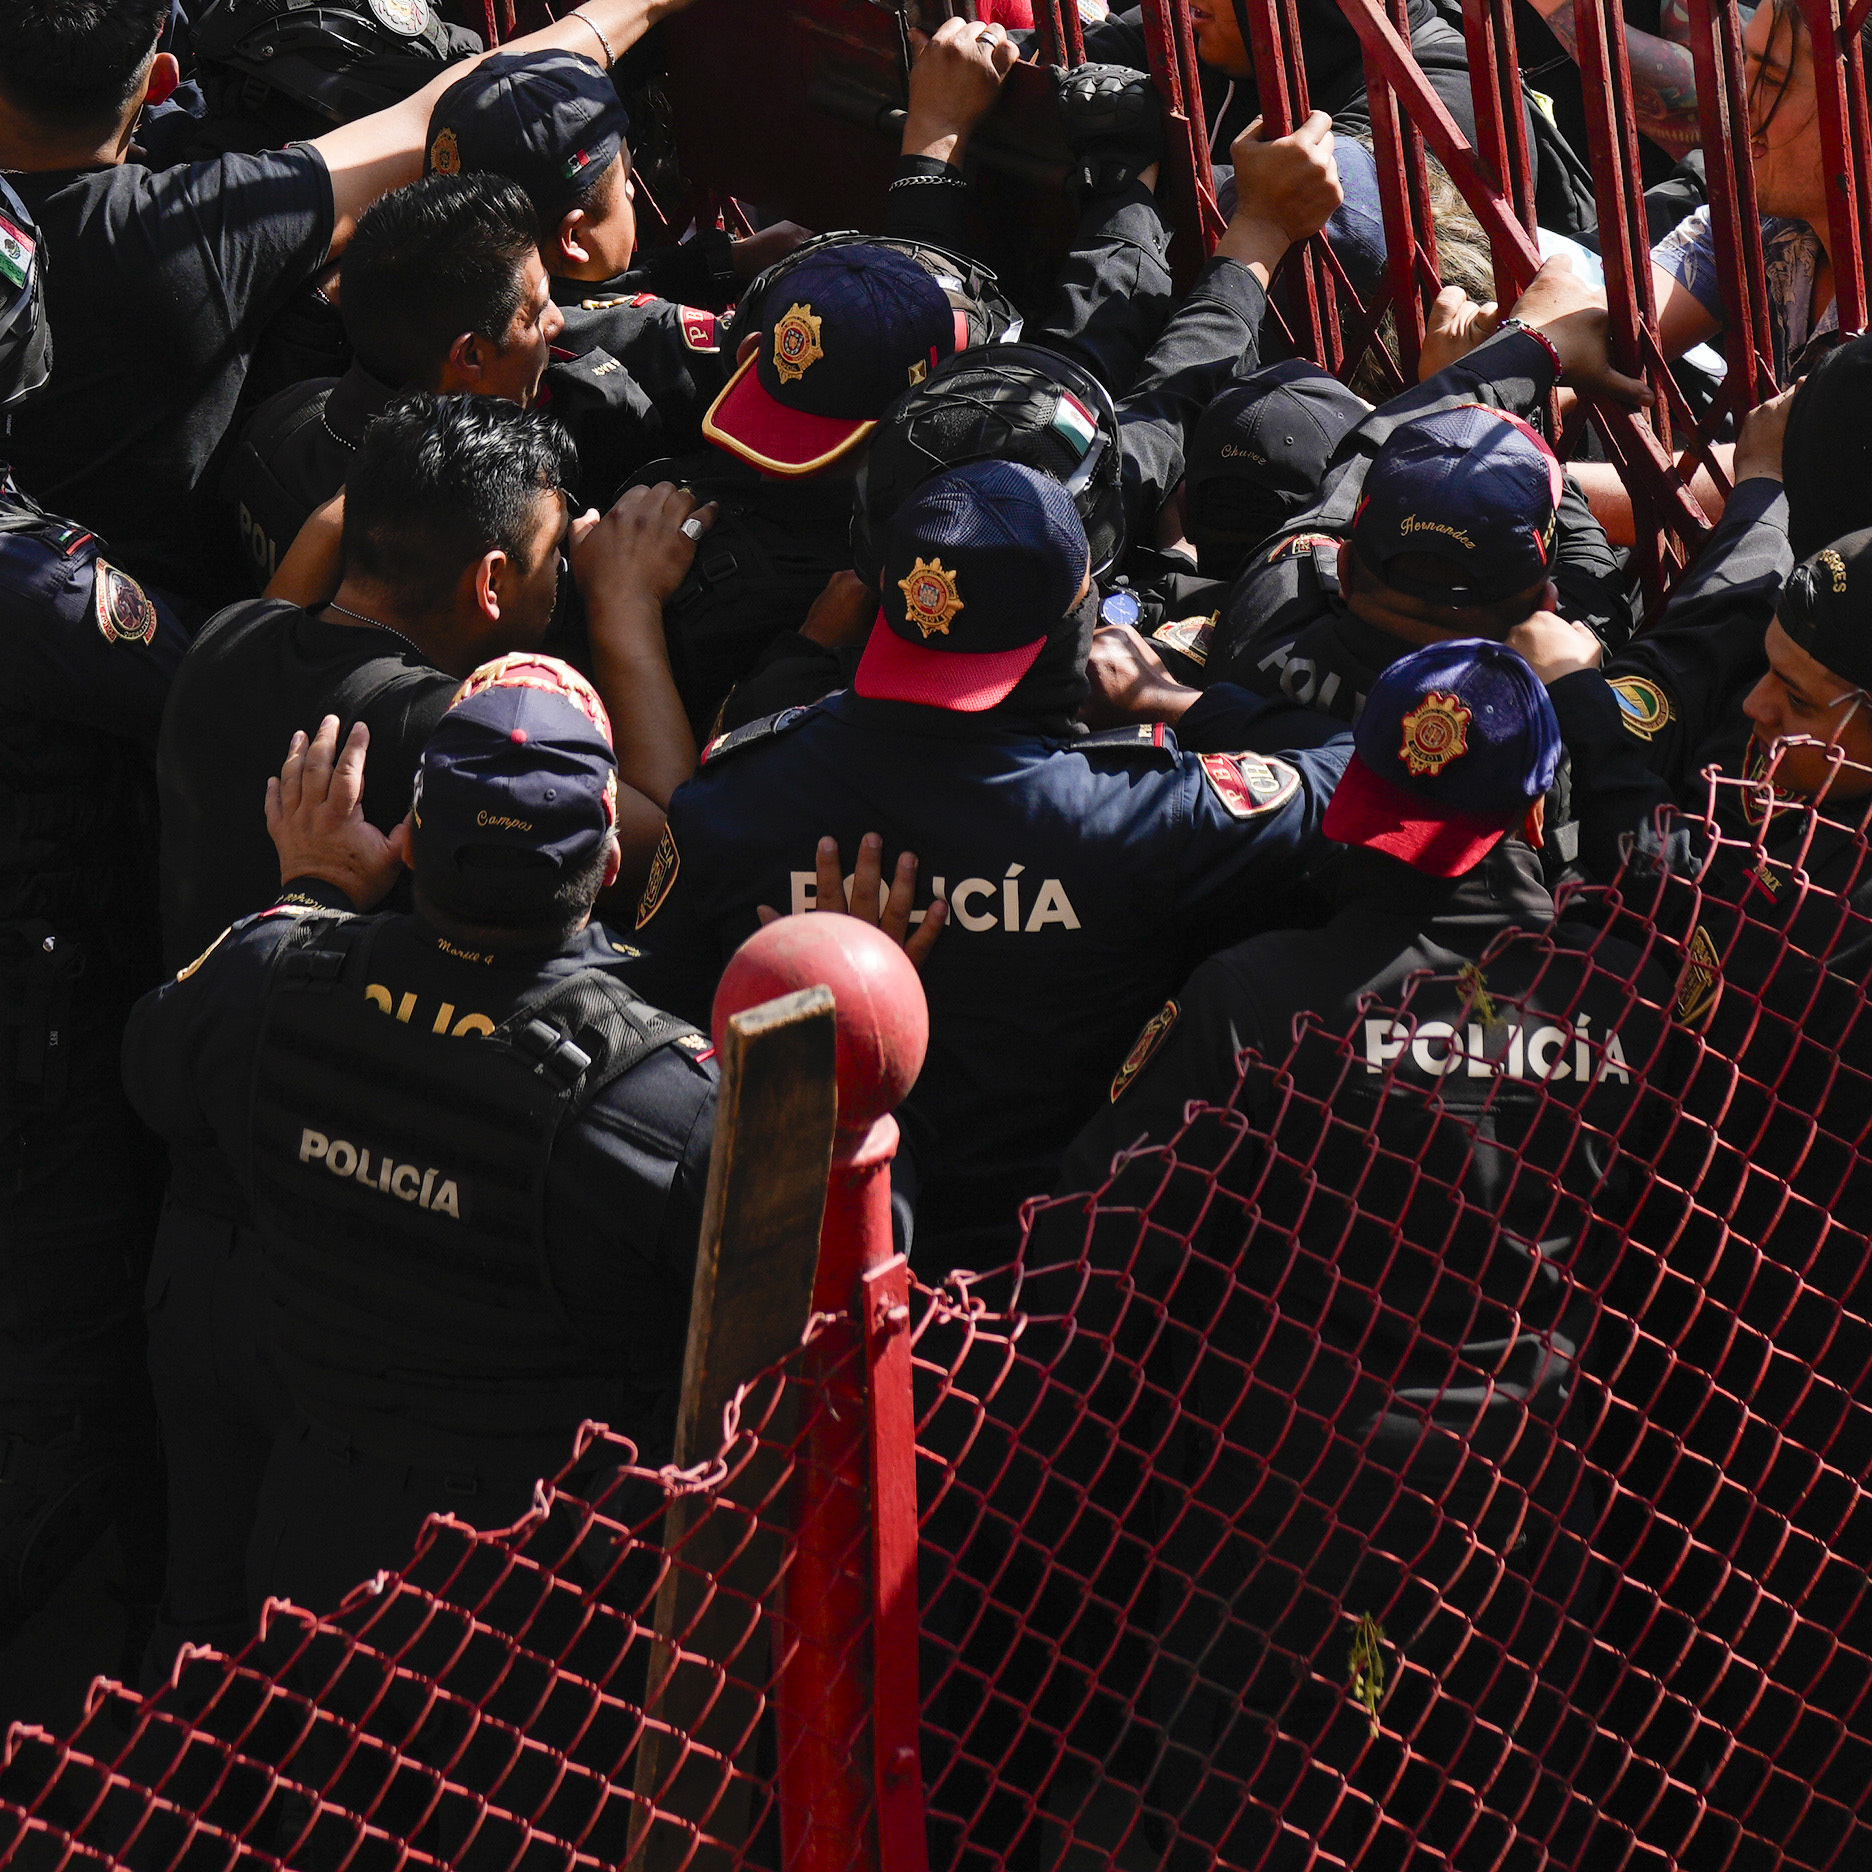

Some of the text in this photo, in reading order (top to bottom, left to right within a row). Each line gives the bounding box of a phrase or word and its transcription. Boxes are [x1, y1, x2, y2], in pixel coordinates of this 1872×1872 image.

[1399, 514, 1478, 551] Hernandez
[476, 808, 534, 834] Campos
[1364, 1012, 1631, 1086] POLICÍA
[299, 1128, 462, 1221] POLICÍA
